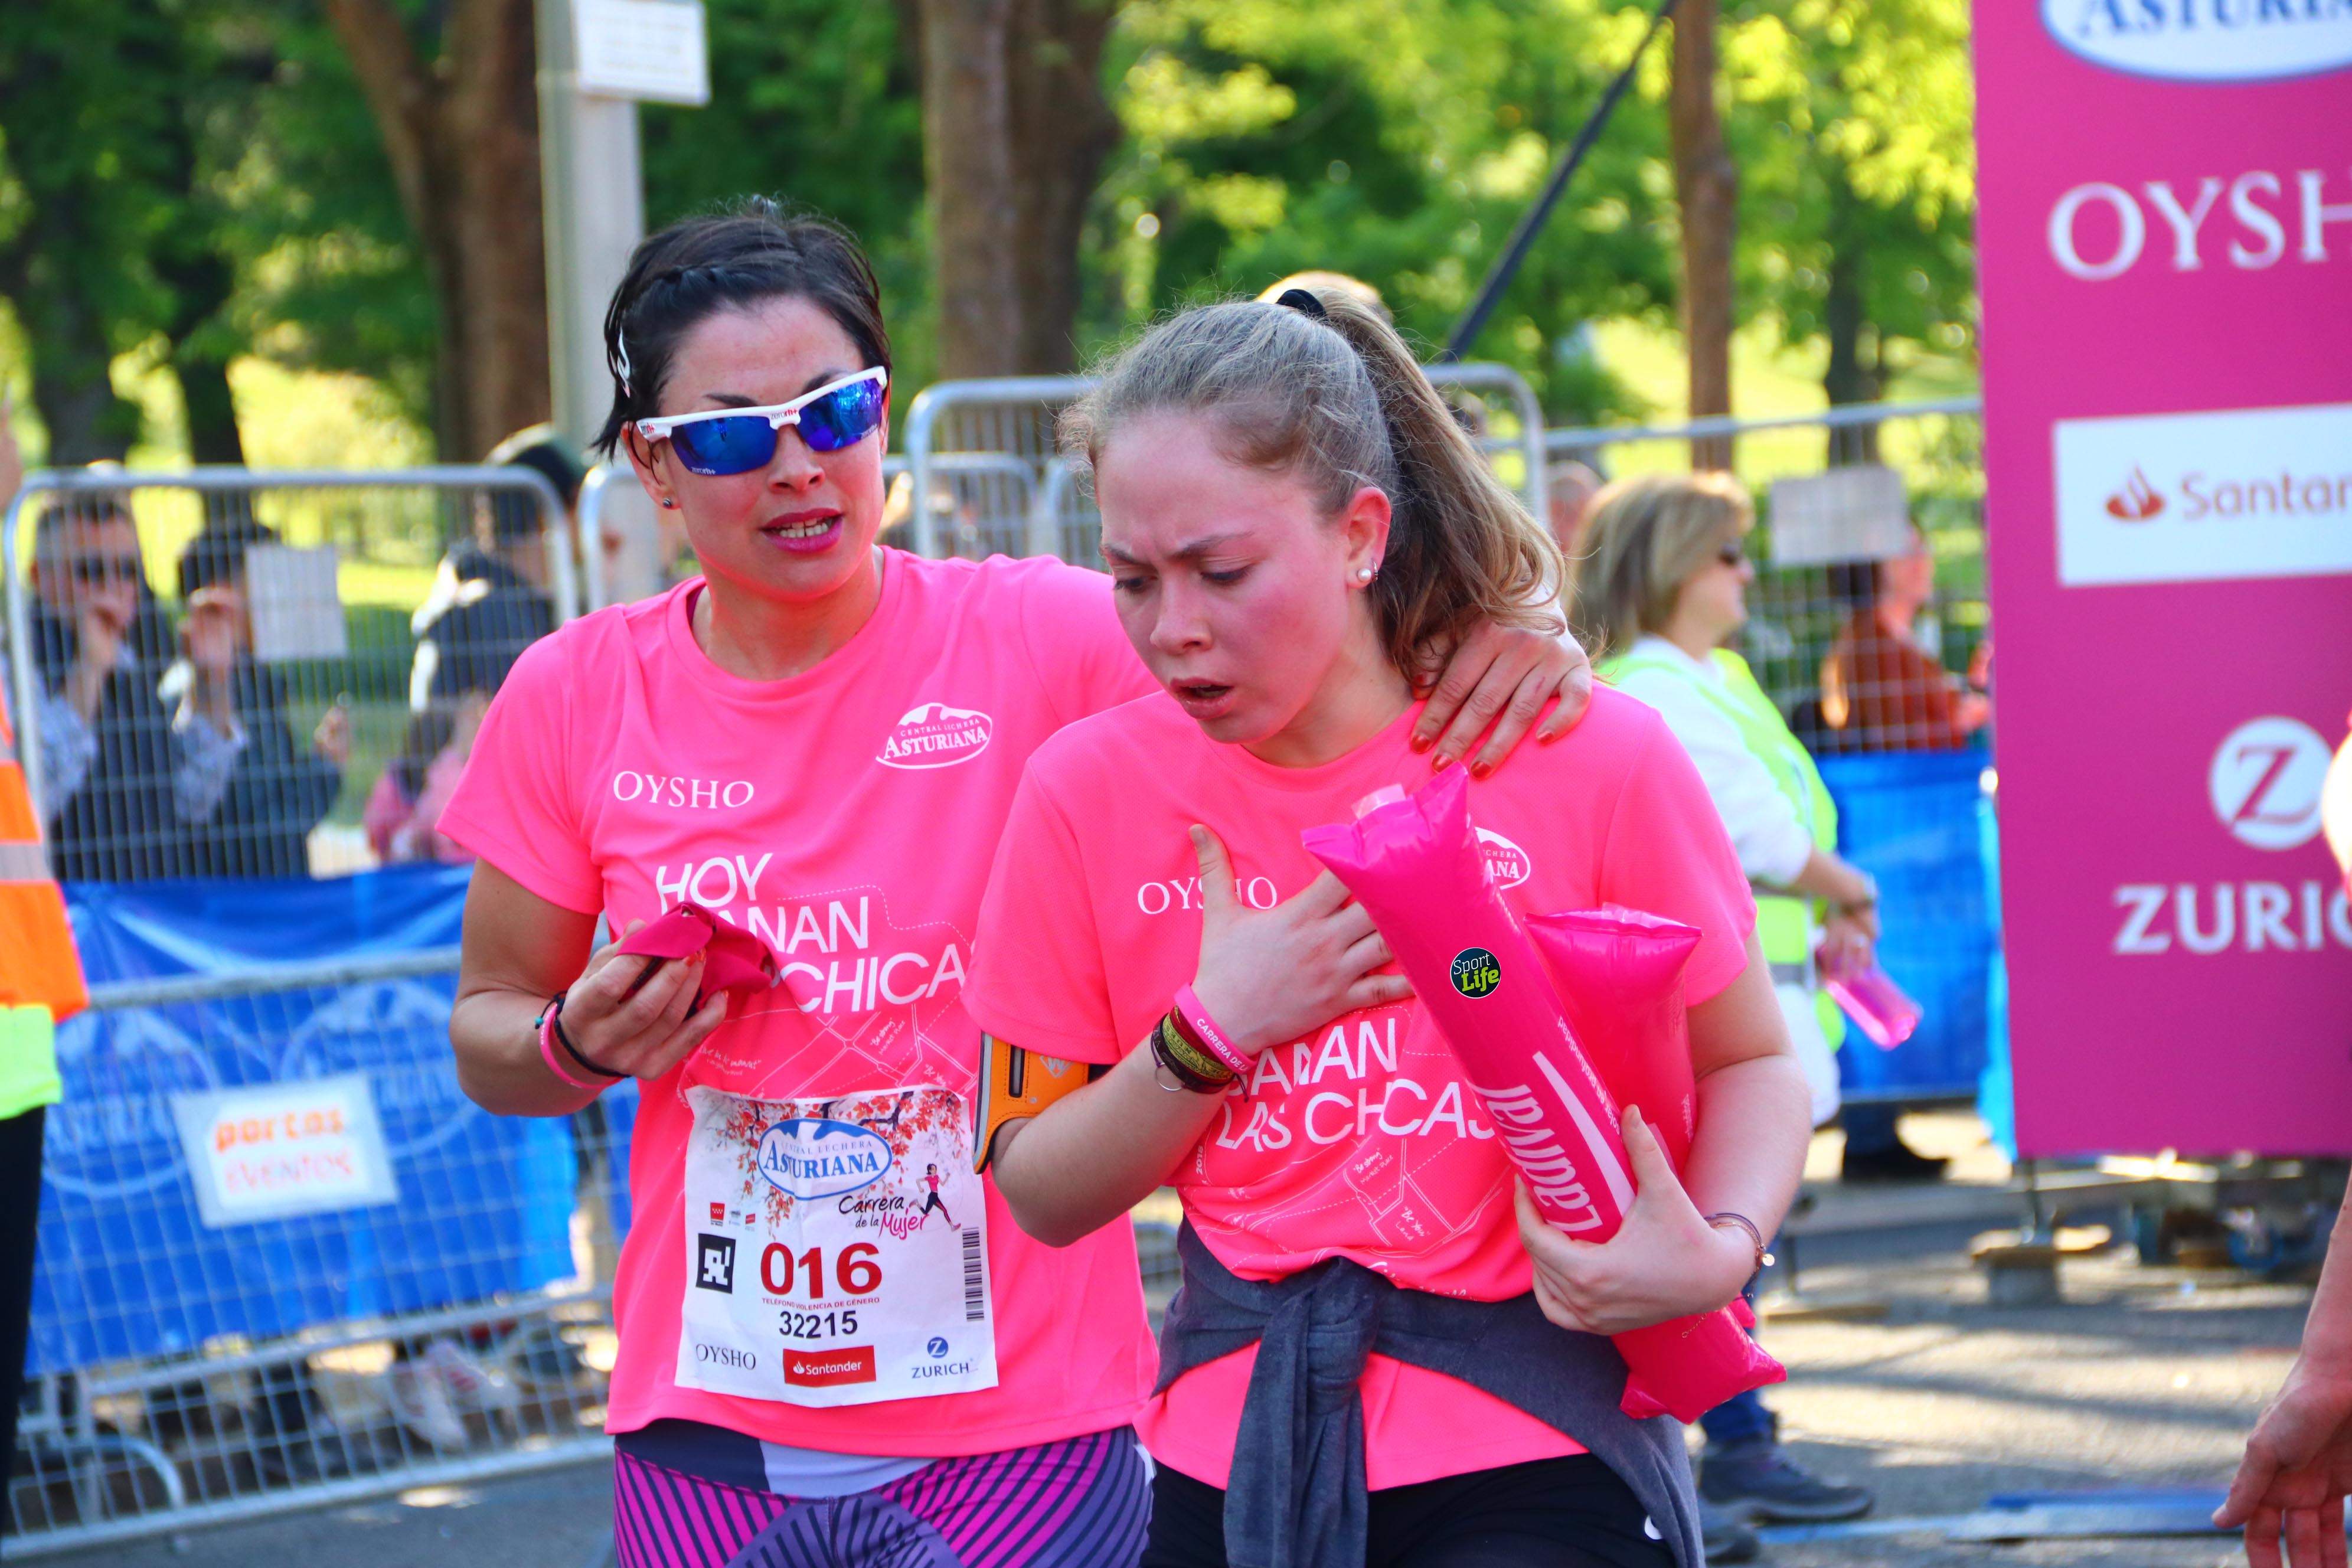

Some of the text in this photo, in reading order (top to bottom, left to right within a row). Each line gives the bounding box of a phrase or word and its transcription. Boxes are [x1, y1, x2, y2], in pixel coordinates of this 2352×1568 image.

[883, 726, 988, 759] ASTURIANA
[901, 725, 941, 737] CENTRAL
[613, 770, 754, 809] OYSHO
[656, 853, 773, 915] HOY
[1138, 877, 1277, 914] OYO
[780, 943, 966, 1013] CHICA
[1453, 953, 1490, 975] Sport
[1461, 967, 1499, 992] Life
[1197, 1018, 1232, 1059] CARRERA
[1230, 1054, 1242, 1068] DE
[1216, 1100, 1292, 1152] LAS
[764, 1140, 880, 1179] ASTURIANA
[818, 1140, 873, 1153] LECHERA
[1466, 1077, 1603, 1232] Ladival
[839, 1195, 904, 1214] Carrera
[855, 1207, 929, 1240] de la Mujer
[760, 1242, 883, 1299] 016
[795, 1302, 832, 1311] VIOLENCIA
[846, 1297, 880, 1306] GÉNERO
[779, 1311, 858, 1338] 32215
[695, 1344, 756, 1370] OYSHO
[806, 1361, 862, 1376] Santander
[912, 1362, 969, 1379] ZURICH
